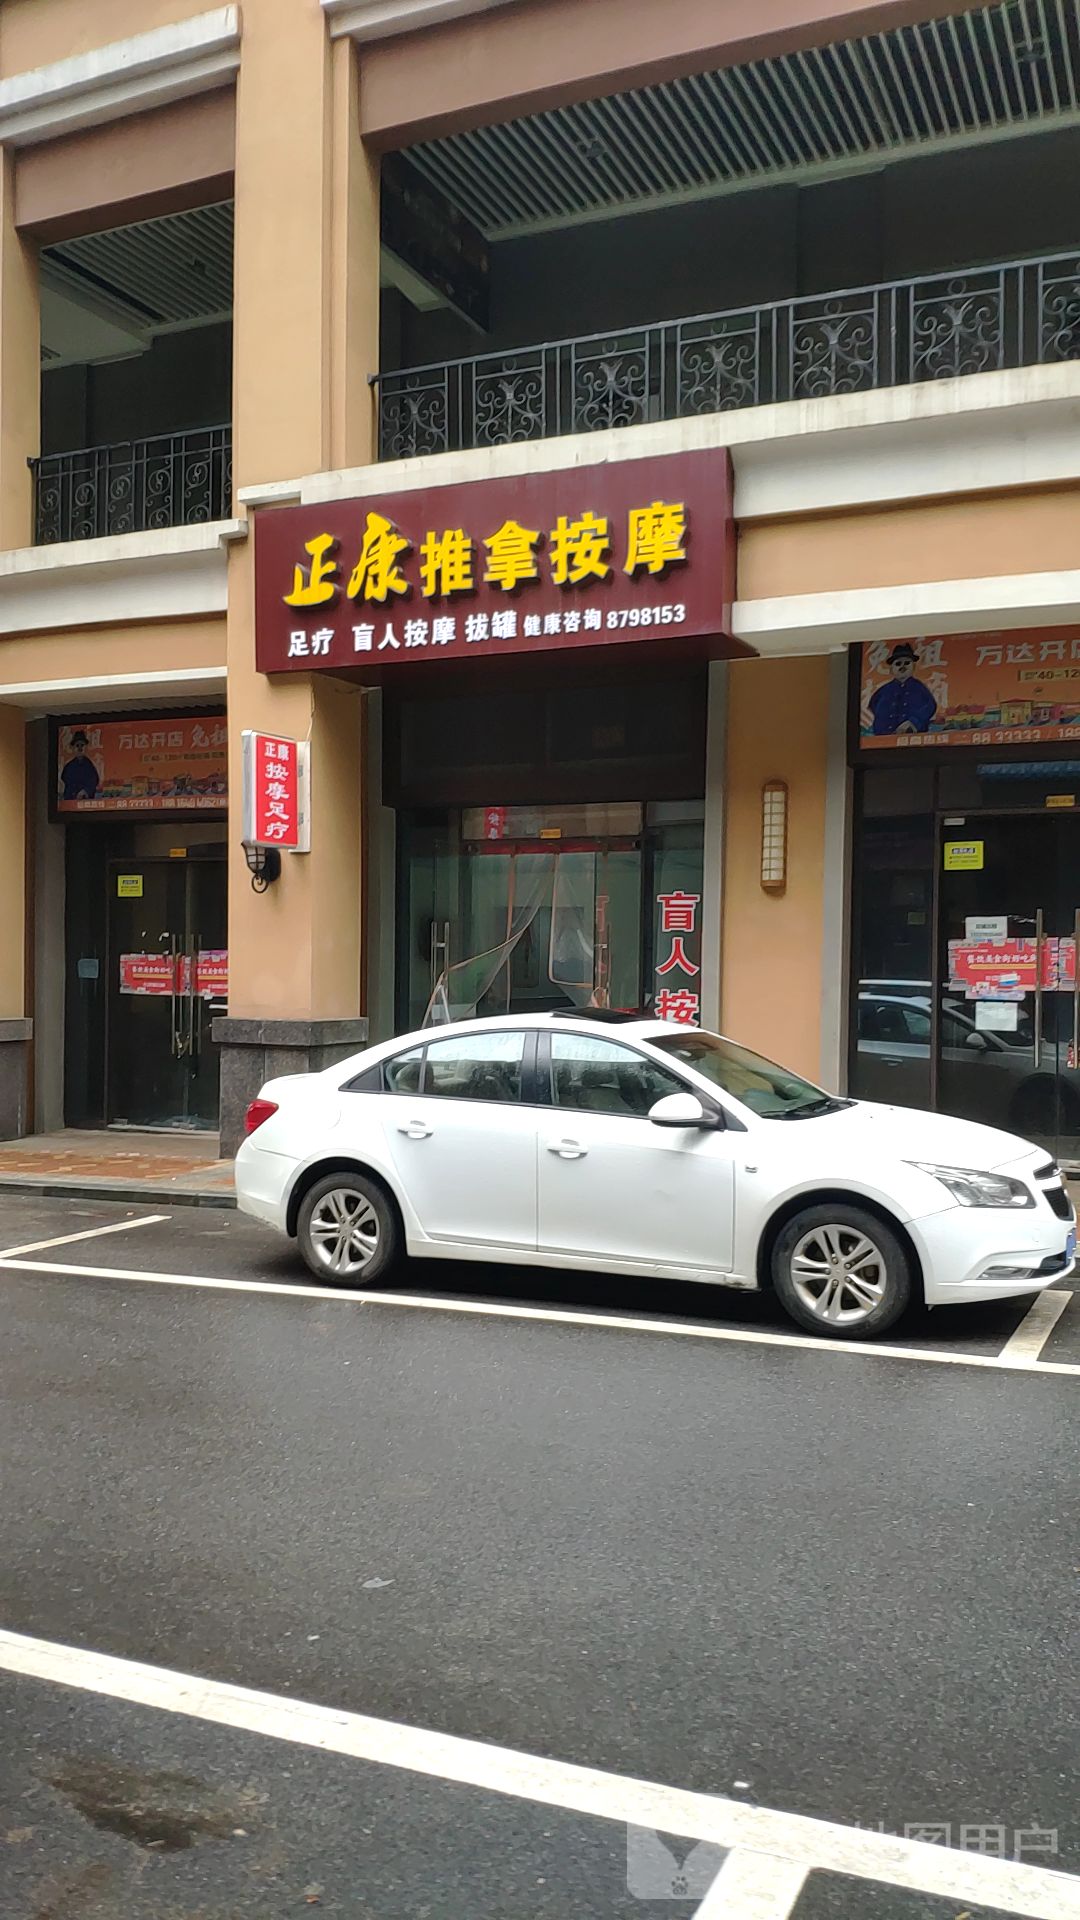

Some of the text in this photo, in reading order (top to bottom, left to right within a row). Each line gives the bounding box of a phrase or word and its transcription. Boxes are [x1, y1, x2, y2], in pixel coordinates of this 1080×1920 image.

[282, 501, 687, 608] 正康推拿按摩
[288, 604, 686, 657] 足疗 盲人按摩 拔罐 健康咨询 8798153
[264, 741, 290, 761] 正康
[264, 762, 290, 839] 按摩足疗
